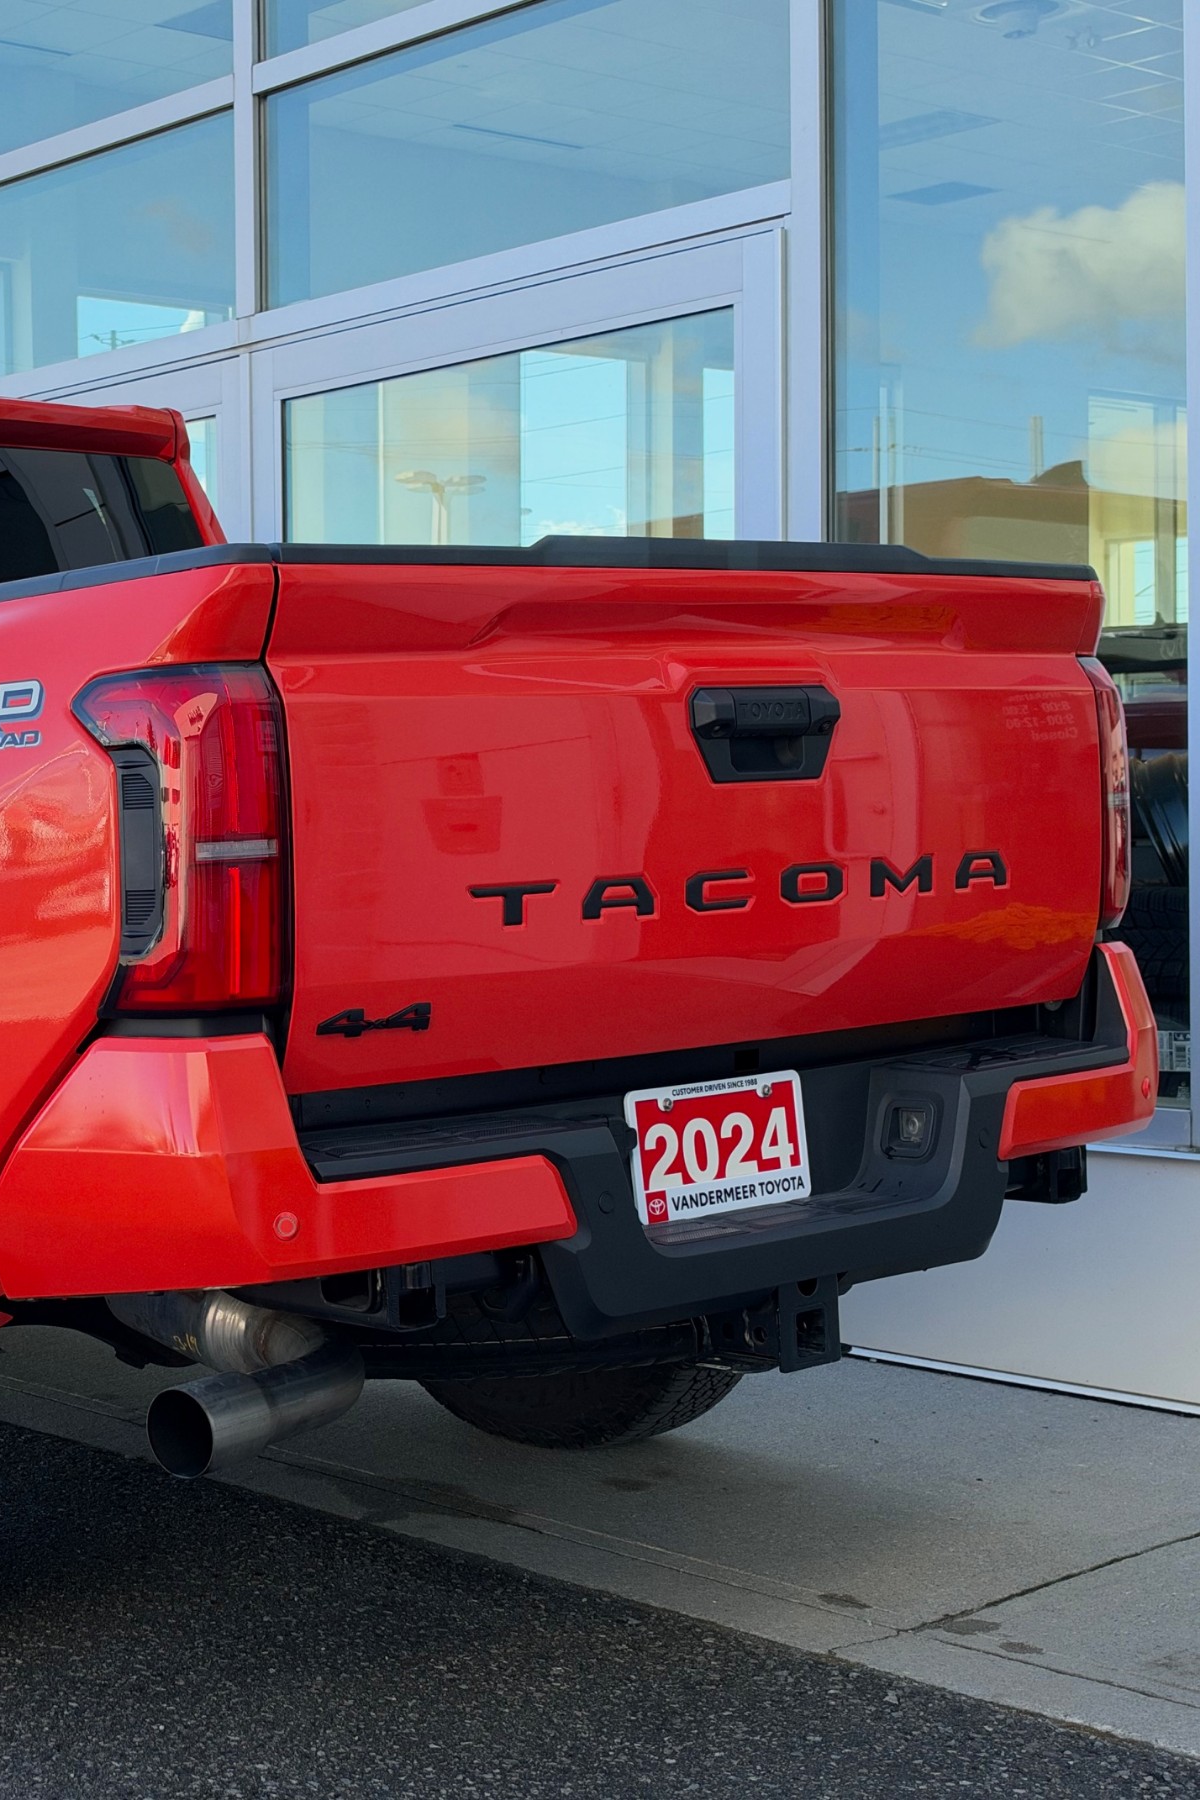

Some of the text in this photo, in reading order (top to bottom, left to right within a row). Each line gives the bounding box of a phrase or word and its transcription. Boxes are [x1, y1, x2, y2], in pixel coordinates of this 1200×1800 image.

[738, 702, 807, 721] TOYOTA
[467, 850, 1008, 927] TACOMA
[672, 1085, 703, 1096] CUSTOMER
[704, 1083, 726, 1092] DRIVEN
[727, 1080, 744, 1089] SINCE
[644, 1106, 794, 1192] 2024
[671, 1175, 805, 1212] VANDERMEER TOYOTA
